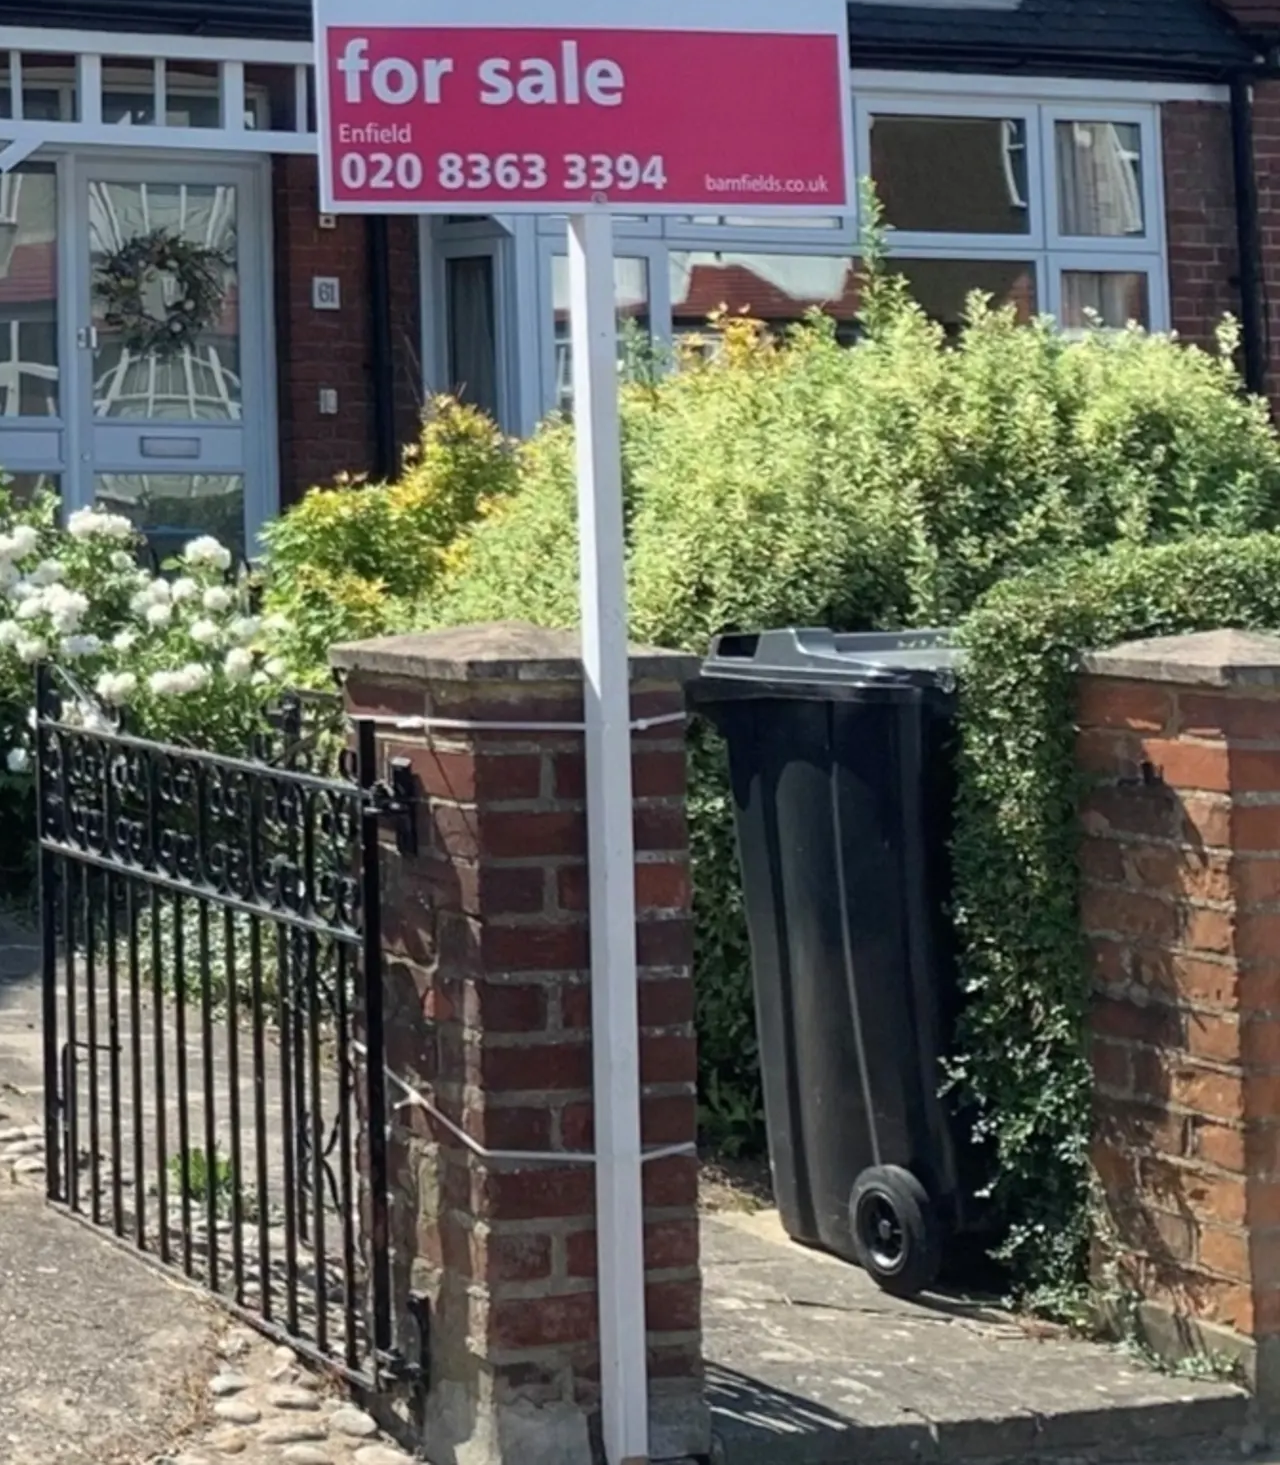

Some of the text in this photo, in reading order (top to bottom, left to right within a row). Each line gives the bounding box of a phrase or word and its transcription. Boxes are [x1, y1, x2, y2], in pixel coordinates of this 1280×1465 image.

[337, 38, 625, 106] for sale
[338, 122, 412, 144] Enfield
[341, 152, 668, 190] 020 8363 3394
[704, 173, 829, 193] barnfields.co.uk
[318, 282, 335, 303] 61
